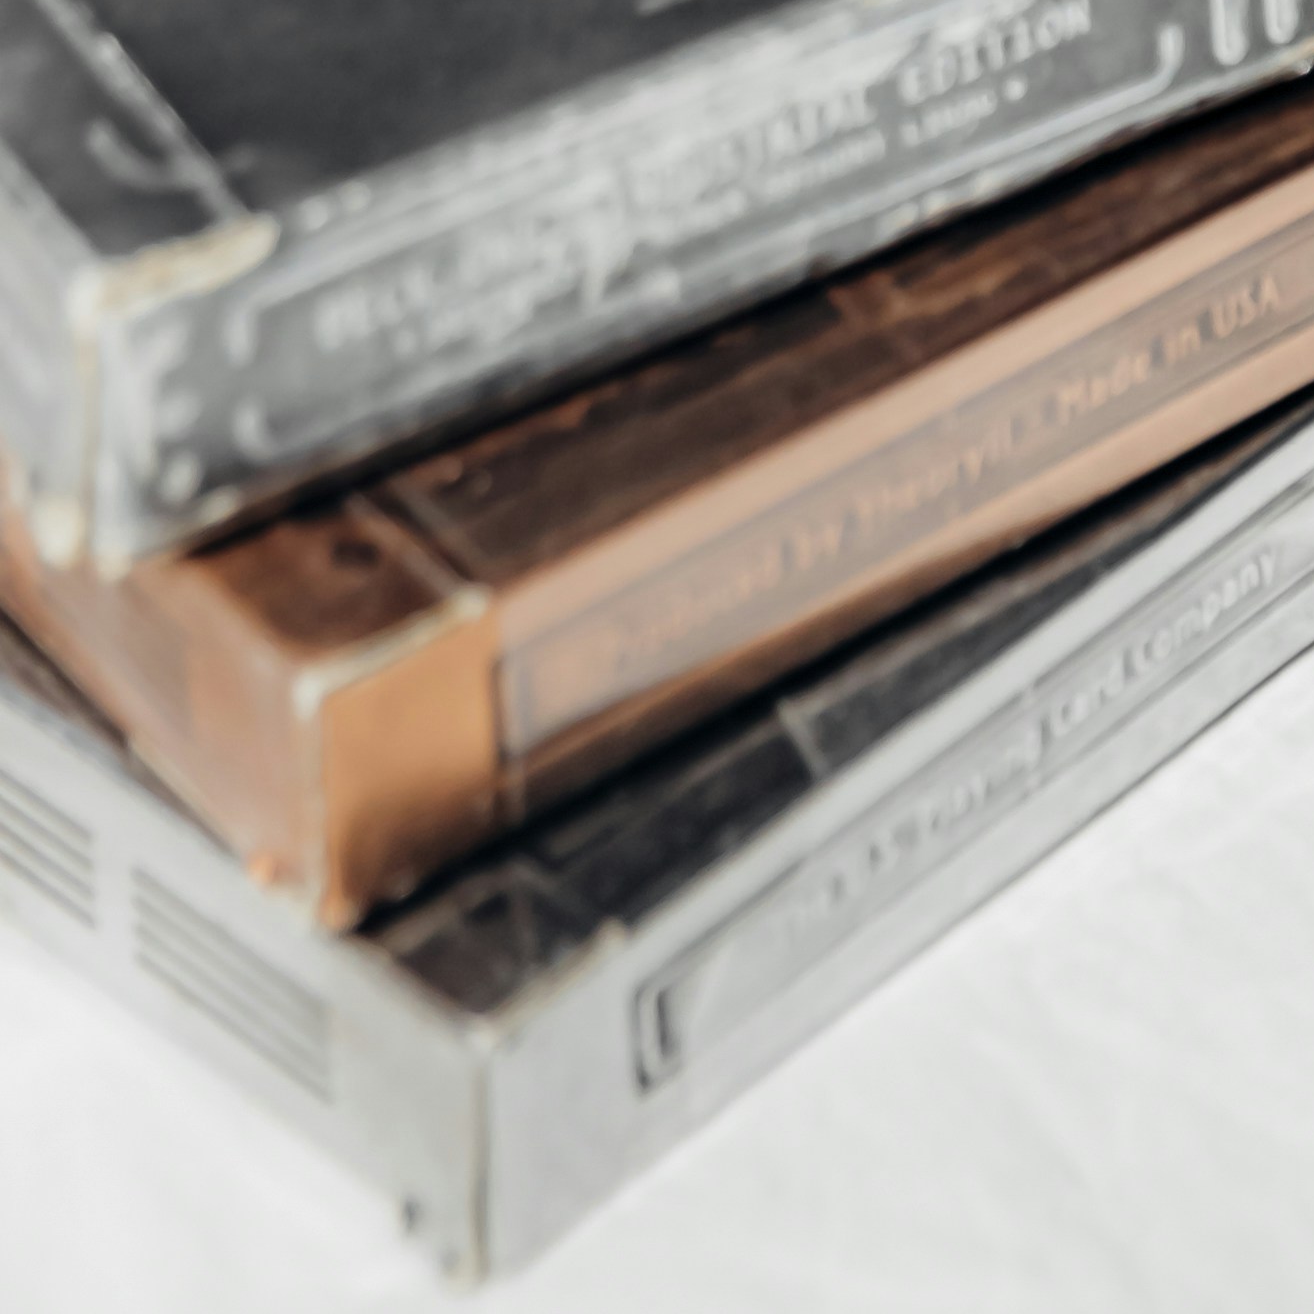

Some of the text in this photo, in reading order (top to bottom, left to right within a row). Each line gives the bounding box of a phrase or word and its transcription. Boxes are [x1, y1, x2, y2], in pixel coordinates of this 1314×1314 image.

[1054, 349, 1154, 418] Made
[1155, 316, 1203, 364] in
[1209, 273, 1285, 339] USA
[1132, 548, 1281, 667] Company
